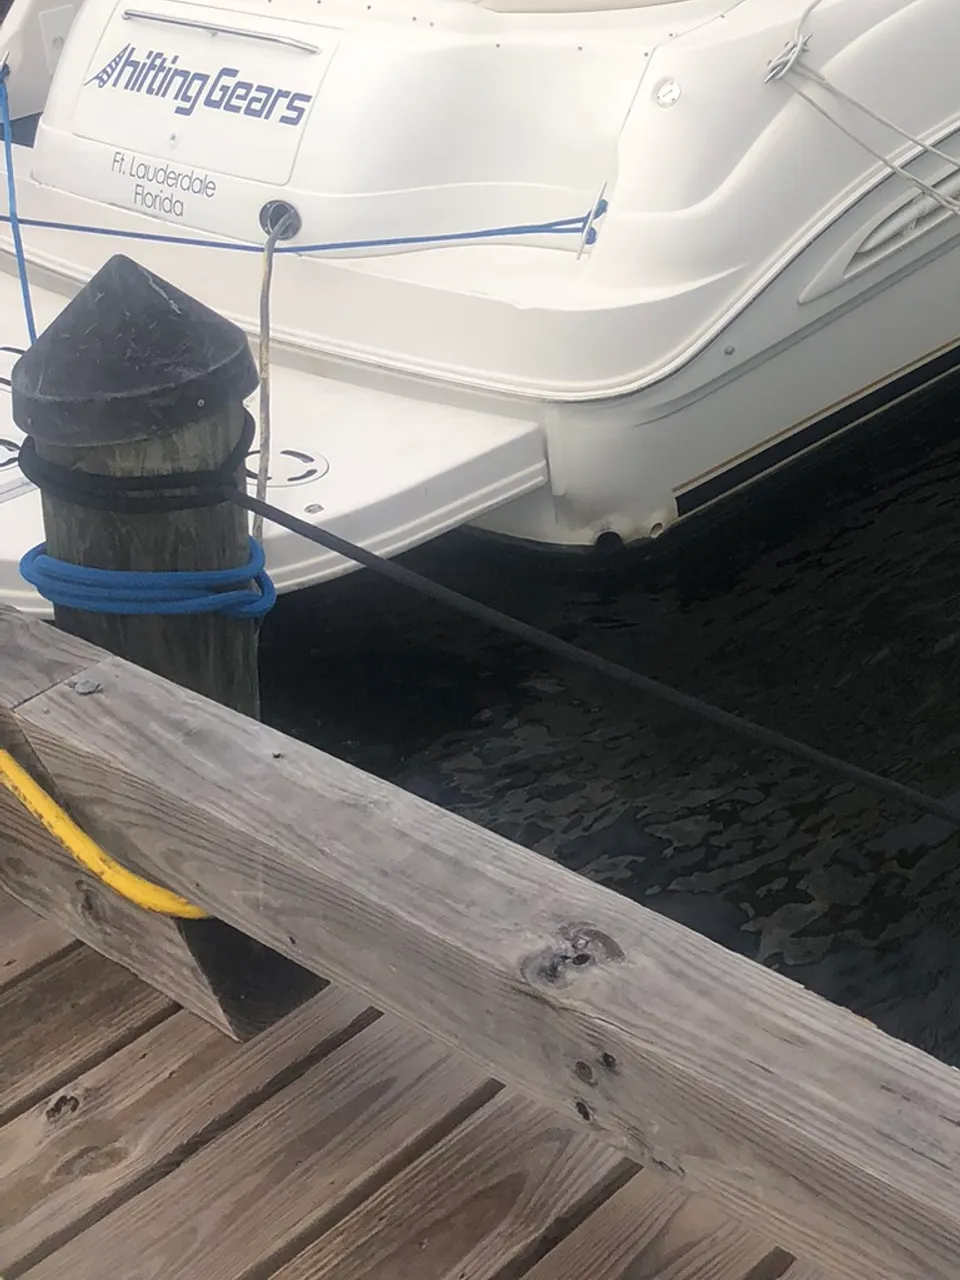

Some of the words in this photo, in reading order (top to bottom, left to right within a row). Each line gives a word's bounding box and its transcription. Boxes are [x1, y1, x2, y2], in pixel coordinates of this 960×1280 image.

[111, 151, 126, 176] Ft.
[129, 155, 217, 198] Lauderdale
[133, 183, 184, 218] Florida
